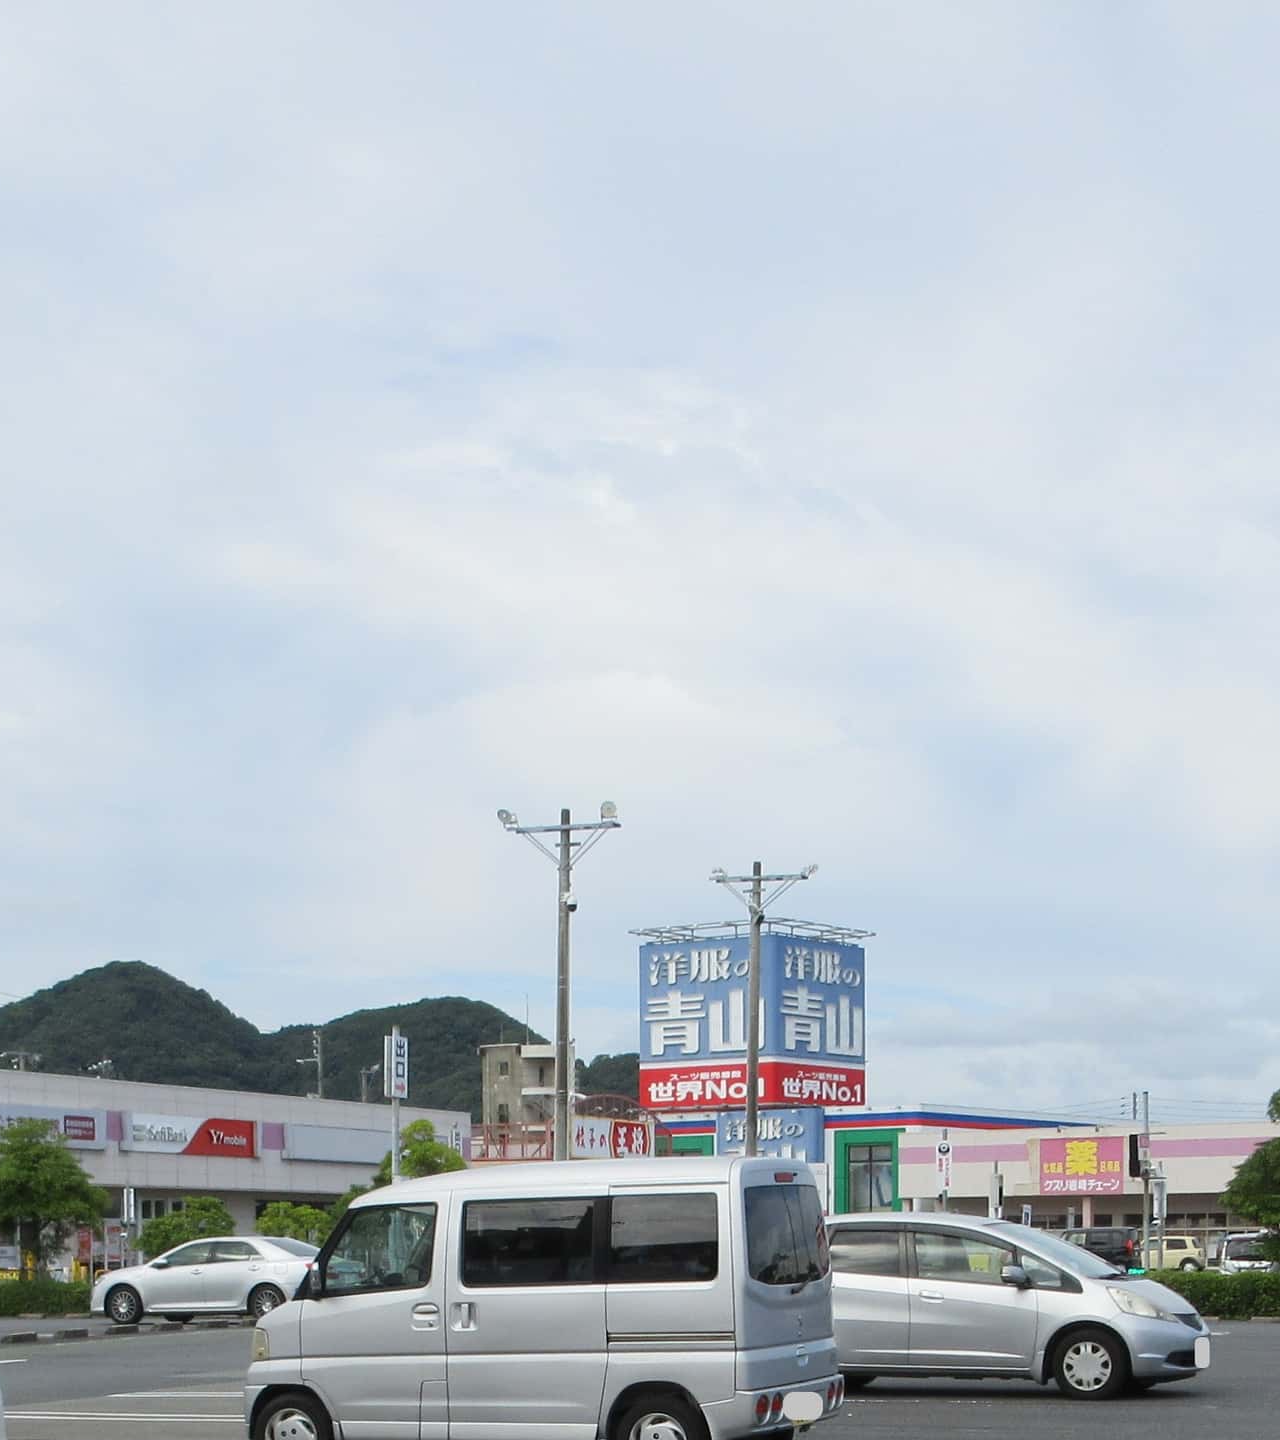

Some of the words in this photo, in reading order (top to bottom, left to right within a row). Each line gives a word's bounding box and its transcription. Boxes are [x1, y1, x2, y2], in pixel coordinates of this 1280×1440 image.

[784, 945, 861, 987] 洋服の
[644, 990, 764, 1056] 青山
[780, 986, 863, 1057] 青山
[648, 1078, 765, 1102] 世界No1
[782, 1077, 861, 1103] 世界No.1
[145, 1124, 188, 1144] SoftBank
[1065, 1140, 1098, 1176] 薬
